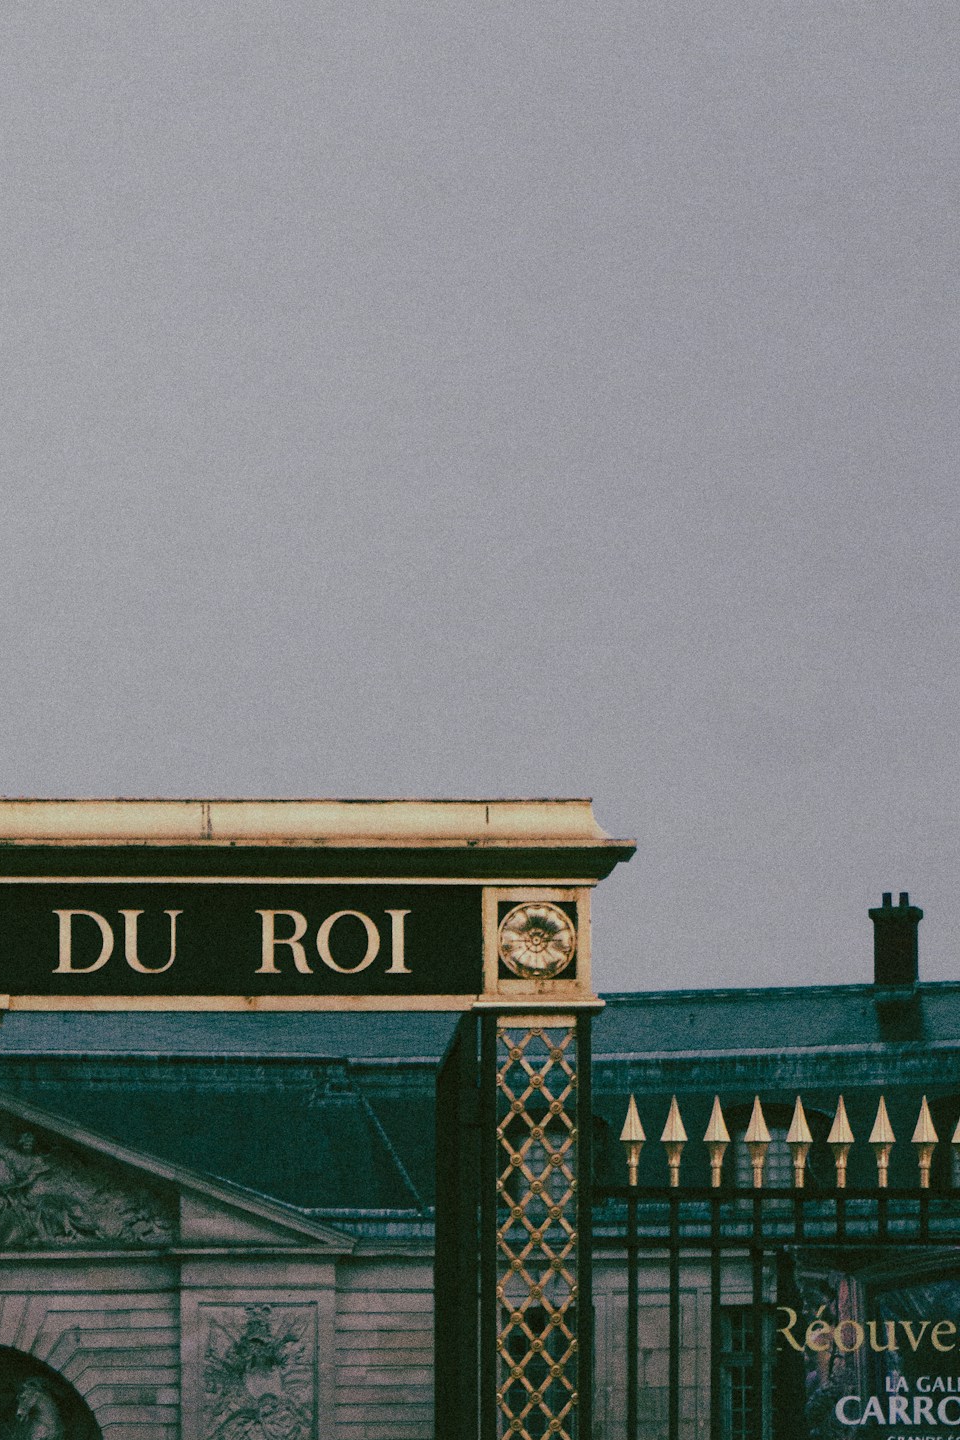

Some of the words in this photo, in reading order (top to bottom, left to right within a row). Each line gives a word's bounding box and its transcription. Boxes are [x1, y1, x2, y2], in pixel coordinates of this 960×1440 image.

[52, 908, 183, 974] DU
[254, 908, 412, 974] ROI
[777, 1304, 960, 1353] Réouve
[885, 1376, 909, 1393] LA
[835, 1396, 960, 1426] CARRO
